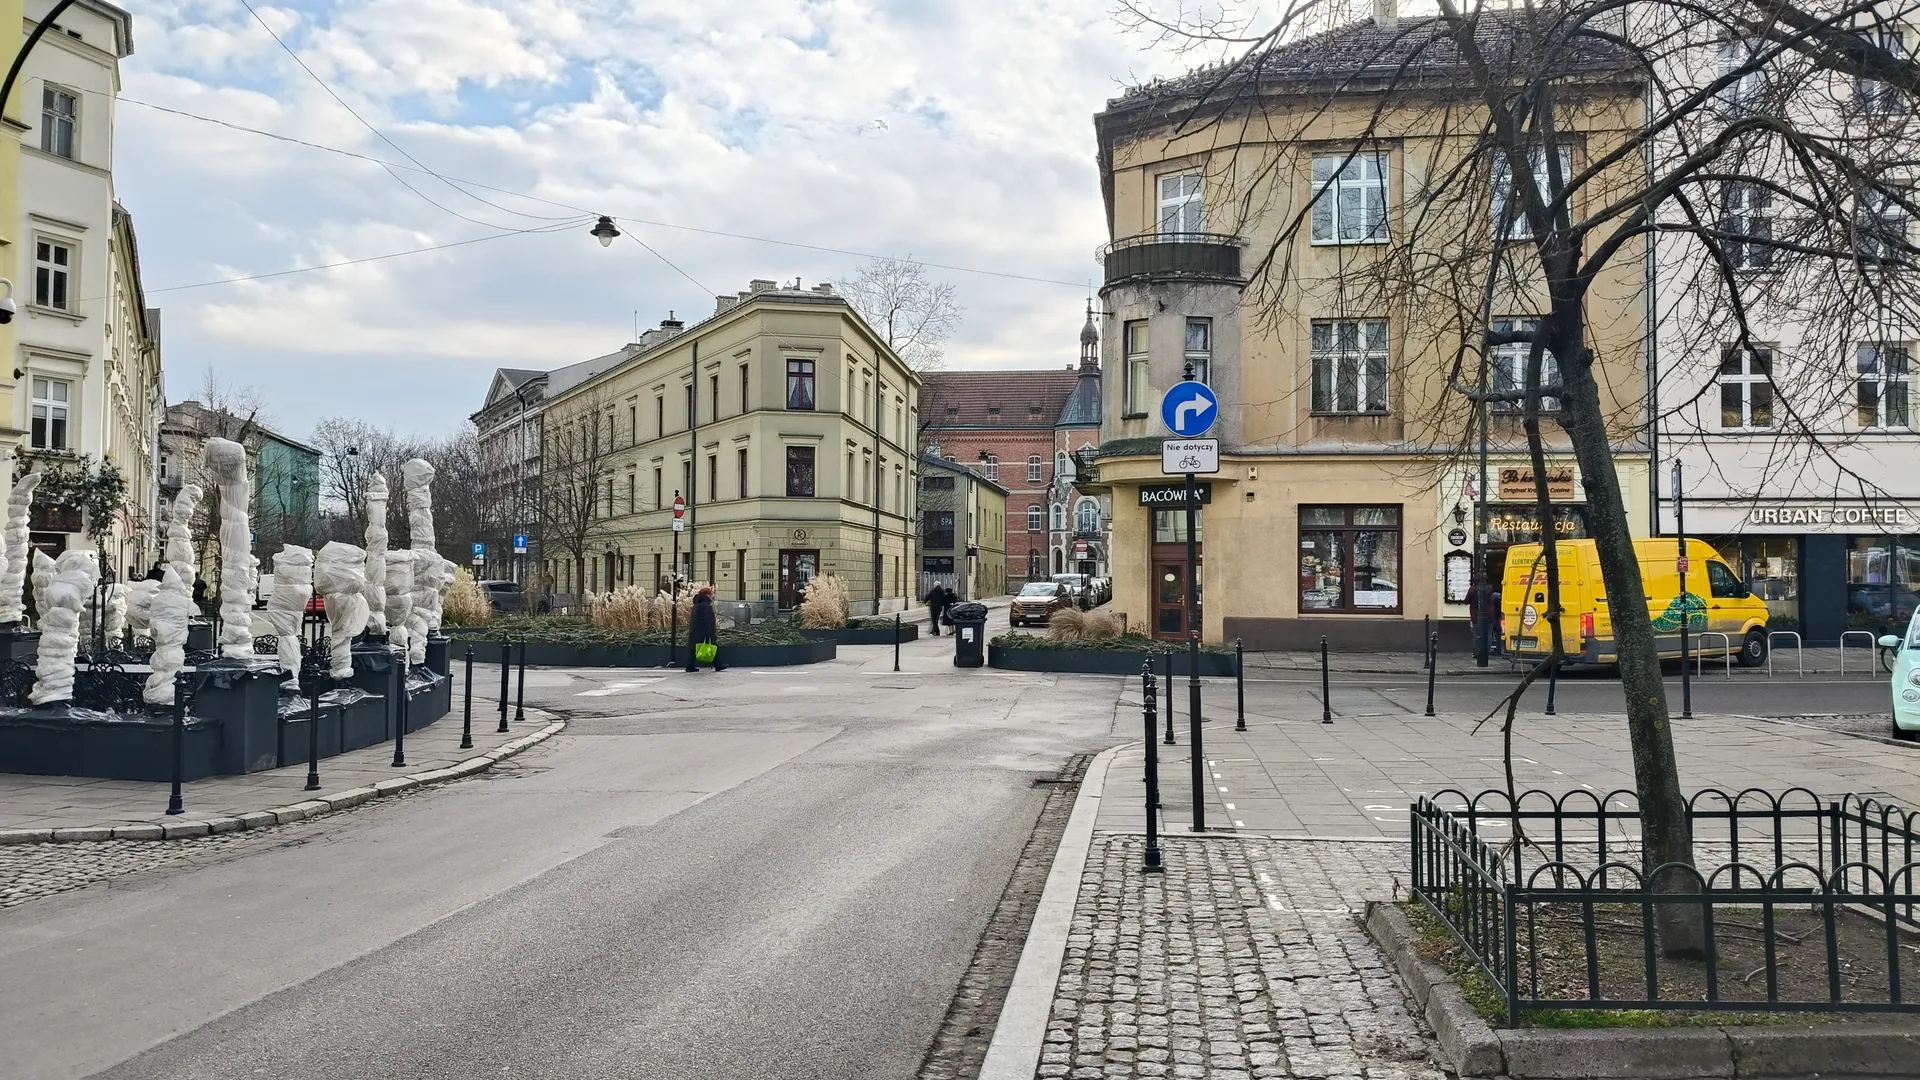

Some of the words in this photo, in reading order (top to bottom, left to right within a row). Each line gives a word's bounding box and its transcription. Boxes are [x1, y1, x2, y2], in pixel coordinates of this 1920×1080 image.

[1183, 443, 1214, 452] dotyczy
[1750, 508, 1822, 523] URBAN
[1833, 508, 1907, 523] COFFEE
[940, 517, 953, 526] SPA
